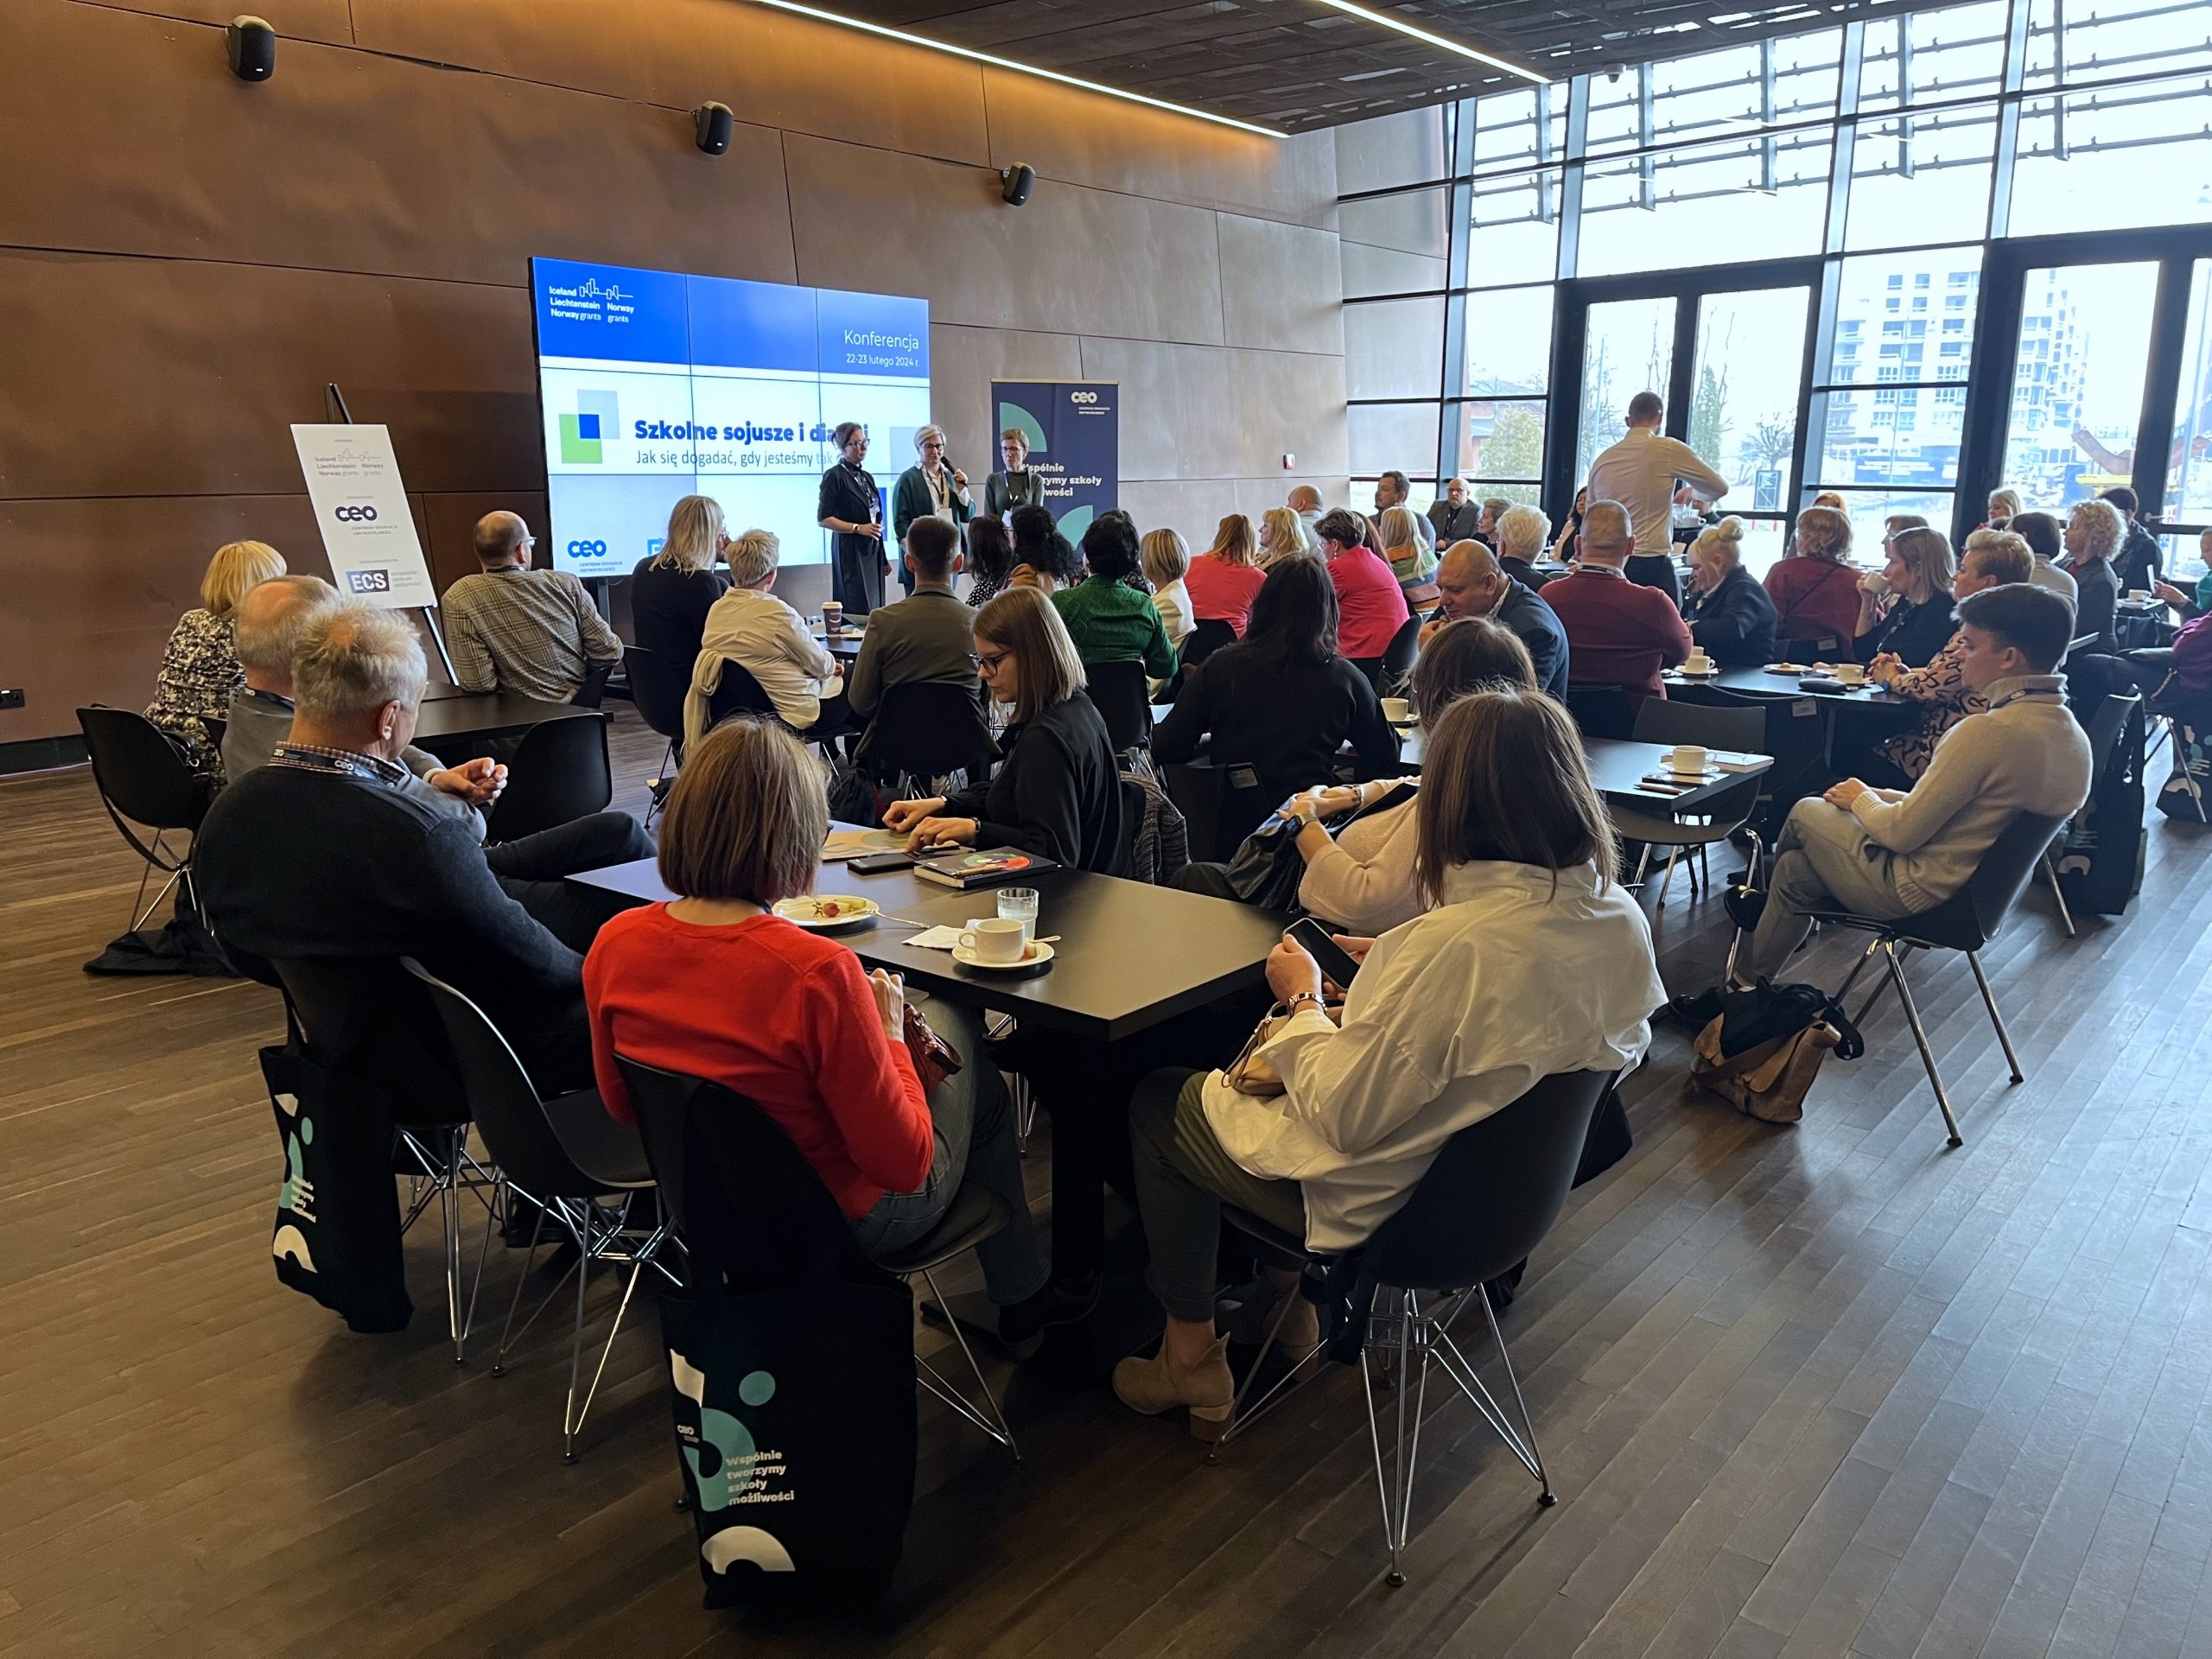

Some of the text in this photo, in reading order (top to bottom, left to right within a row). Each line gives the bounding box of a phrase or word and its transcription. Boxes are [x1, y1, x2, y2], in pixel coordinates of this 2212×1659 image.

[549, 286, 577, 296] Iceland
[550, 297, 601, 309] Liechtenstein
[607, 302, 634, 314] Norway
[550, 308, 601, 321] Norway grants
[607, 315, 629, 323] grants
[844, 329, 919, 352] Konferencja
[846, 353, 868, 364] 22-23
[868, 355, 894, 367] lutego
[895, 357, 913, 366] 2024
[634, 420, 718, 440] Szkolne
[723, 421, 794, 445] sojusze
[799, 423, 804, 442] i
[636, 449, 657, 464] Jak
[660, 450, 678, 467] się
[682, 449, 737, 467] dogadać,
[741, 452, 761, 467] gdy
[764, 451, 813, 467] jesteśmy
[816, 451, 834, 465] tak
[1069, 476, 1103, 486] szkoły
[351, 574, 386, 589] ECS
[726, 1450, 783, 1465] Wspólnie
[727, 1465, 787, 1479] tworzymy
[728, 1479, 768, 1493] szkoły
[728, 1491, 795, 1505] możliwości
